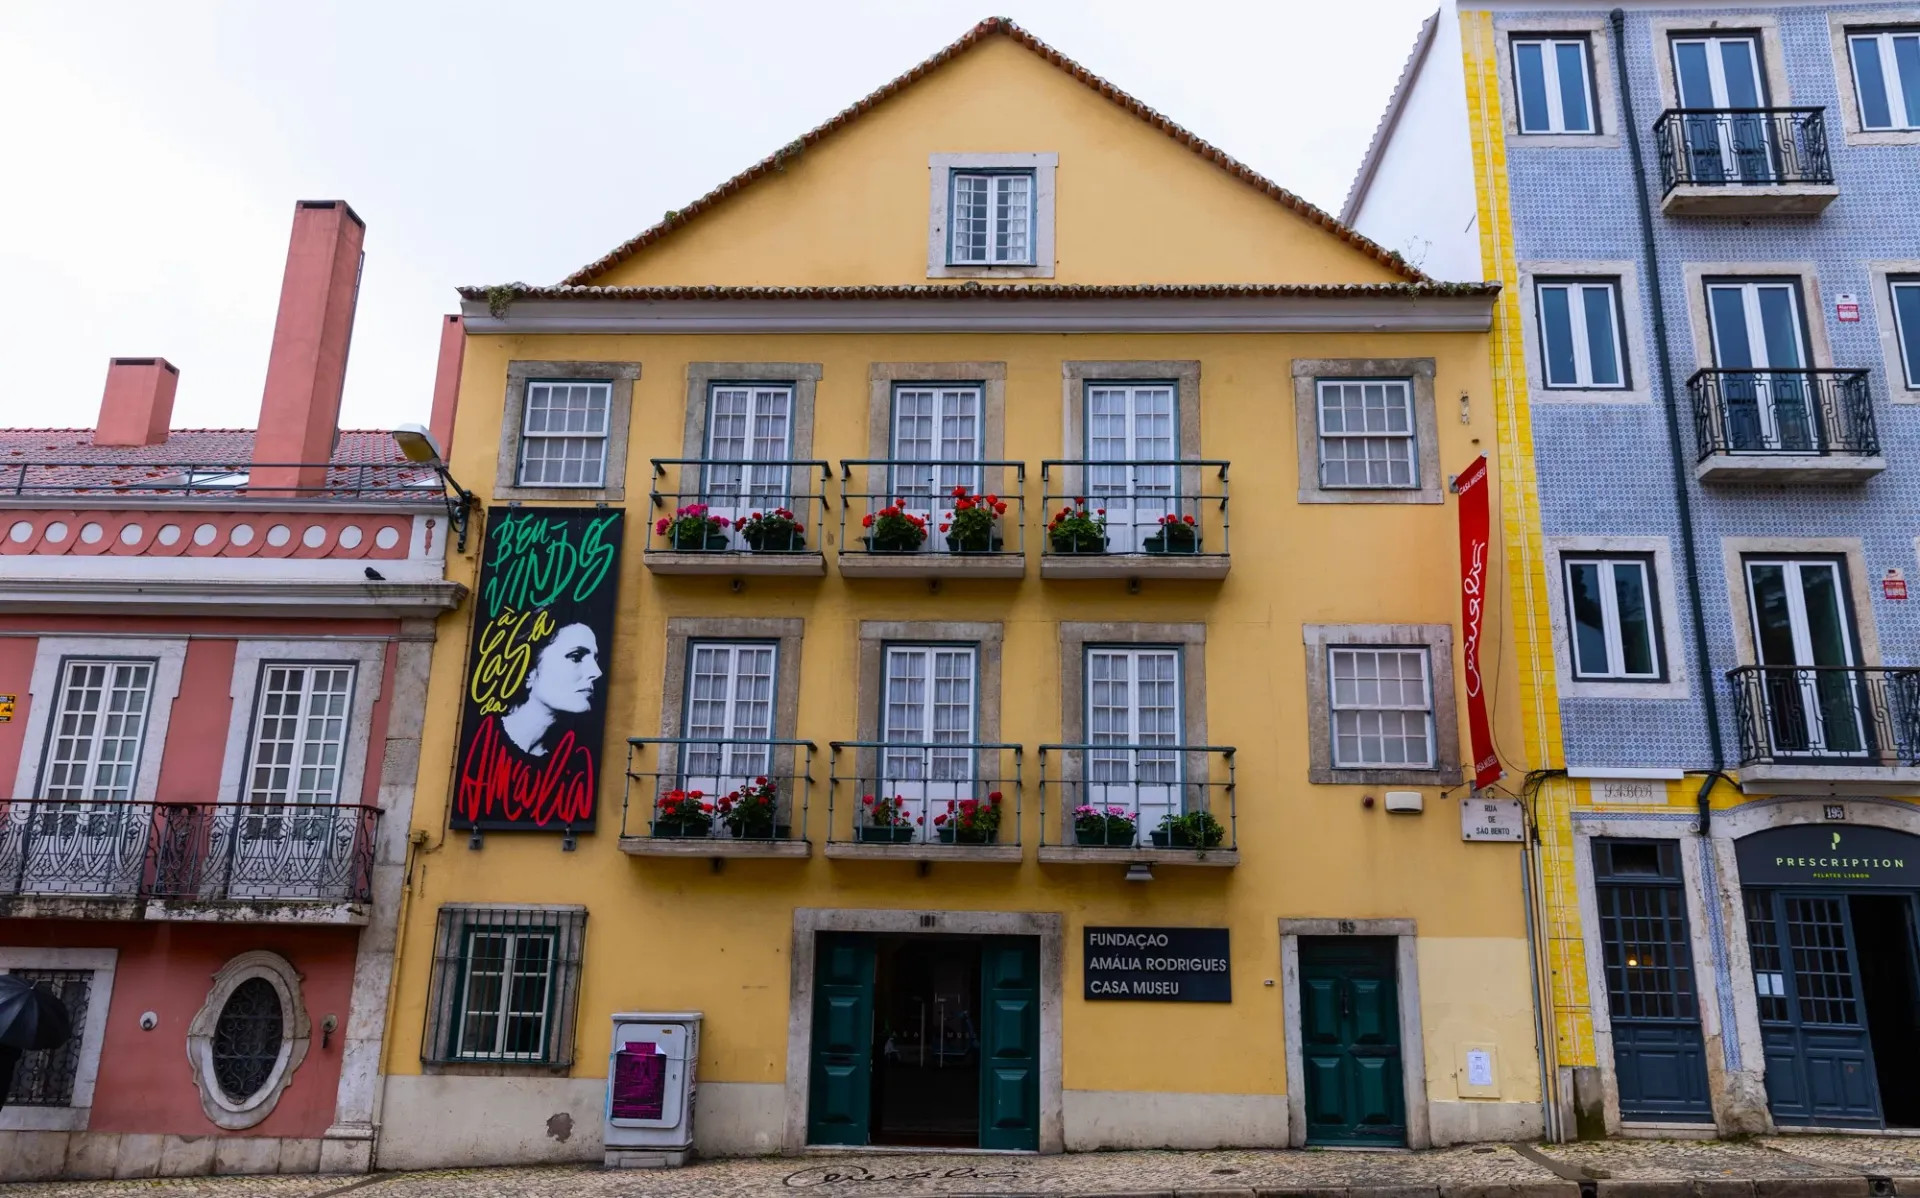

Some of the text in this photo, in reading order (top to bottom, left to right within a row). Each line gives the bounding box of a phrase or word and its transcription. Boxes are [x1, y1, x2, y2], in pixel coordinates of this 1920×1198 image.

[1484, 804, 1498, 813] RUA
[1827, 807, 1844, 819] 195
[1487, 815, 1497, 824] DE
[1490, 827, 1510, 836] BENTO
[1776, 857, 1904, 868] PRESCRIPTION
[1089, 953, 1227, 972] AMÁLIA RODRIGUES
[1090, 980, 1179, 995] CASA MUSEU
